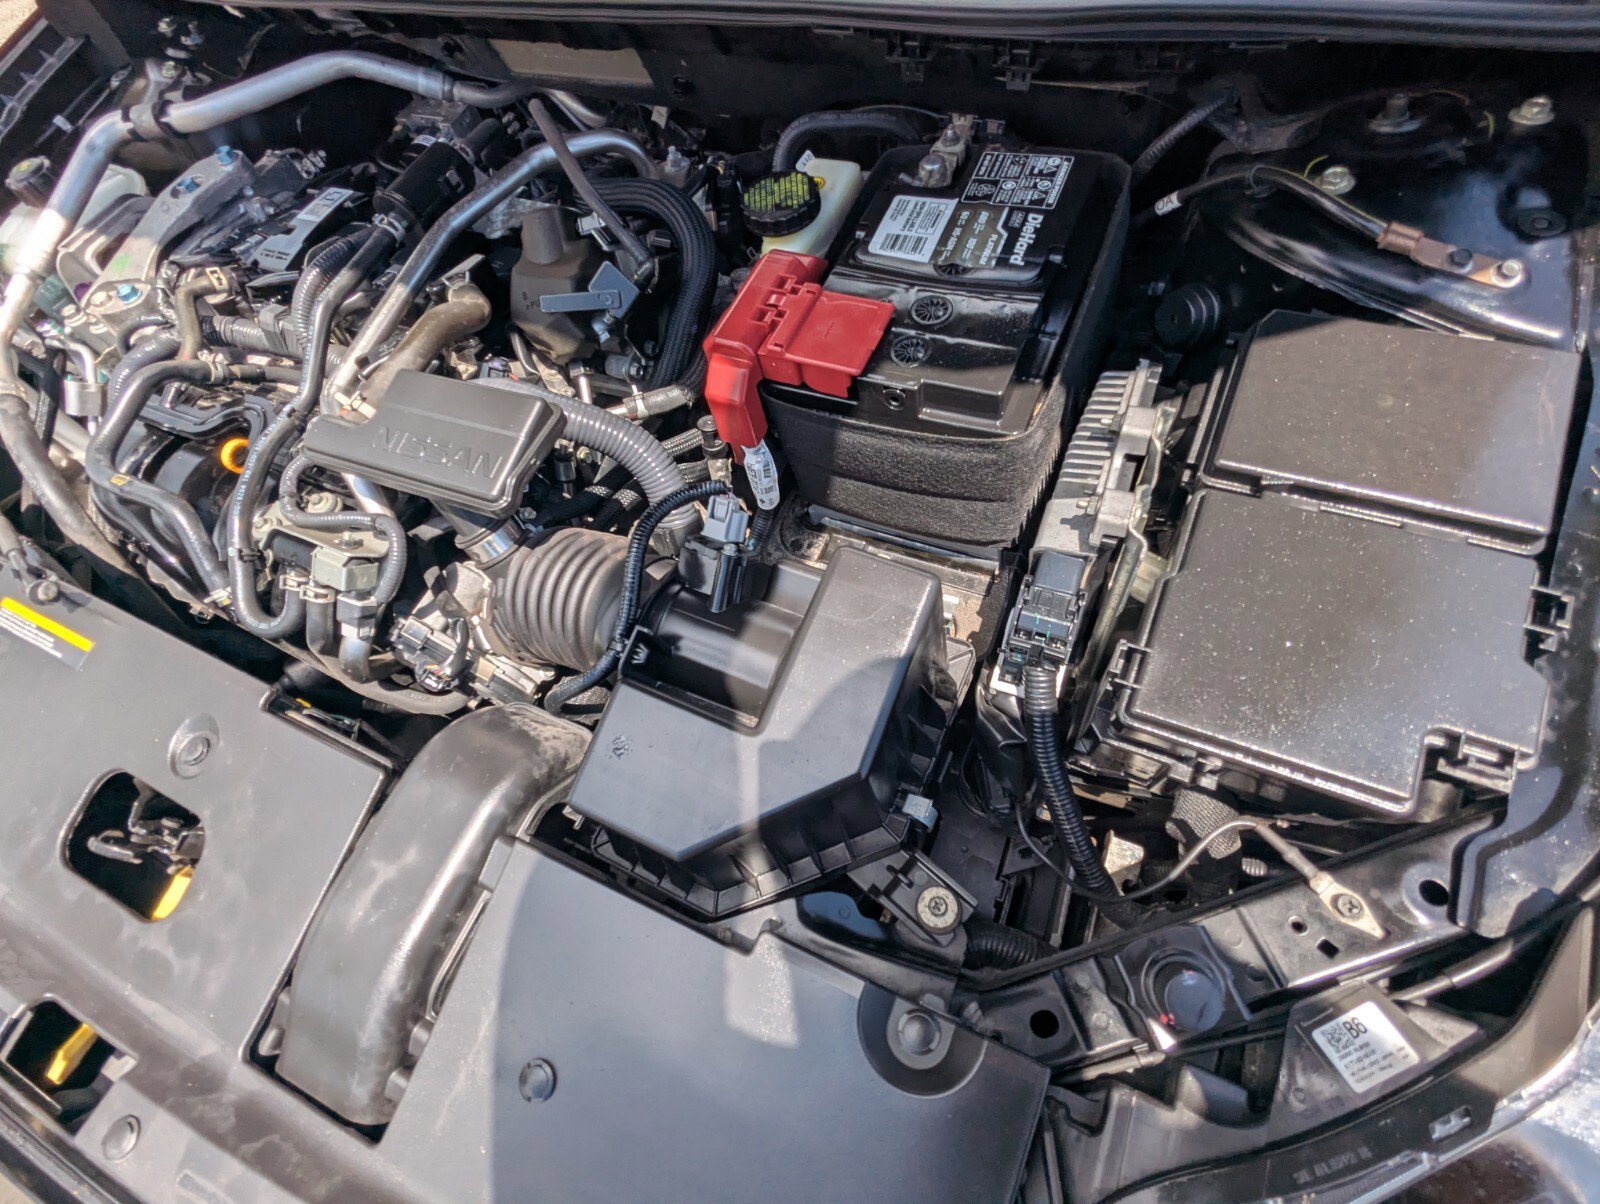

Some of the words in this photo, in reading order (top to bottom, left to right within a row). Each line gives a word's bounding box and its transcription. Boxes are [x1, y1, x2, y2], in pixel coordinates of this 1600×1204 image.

[979, 233, 998, 266] PLATINUM
[1008, 213, 1044, 266] DieHard
[372, 424, 503, 479] NISSAN
[1343, 1017, 1368, 1039] B6
